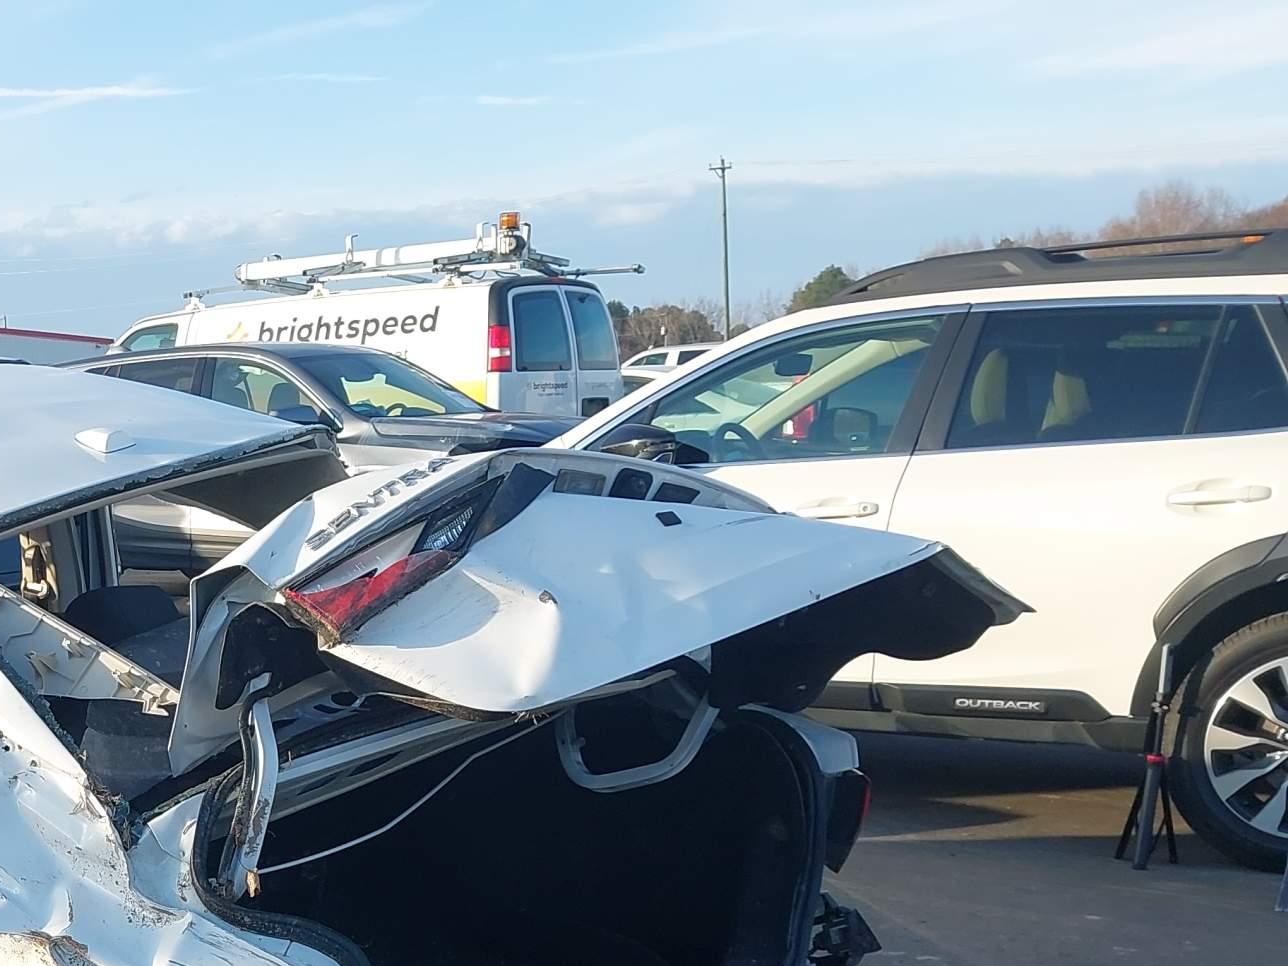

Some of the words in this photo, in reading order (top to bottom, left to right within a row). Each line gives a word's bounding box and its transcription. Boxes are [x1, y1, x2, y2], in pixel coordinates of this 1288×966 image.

[258, 305, 440, 345] brightspeed
[304, 457, 457, 551] SENTRA
[955, 698, 1041, 711] OUTBACK
